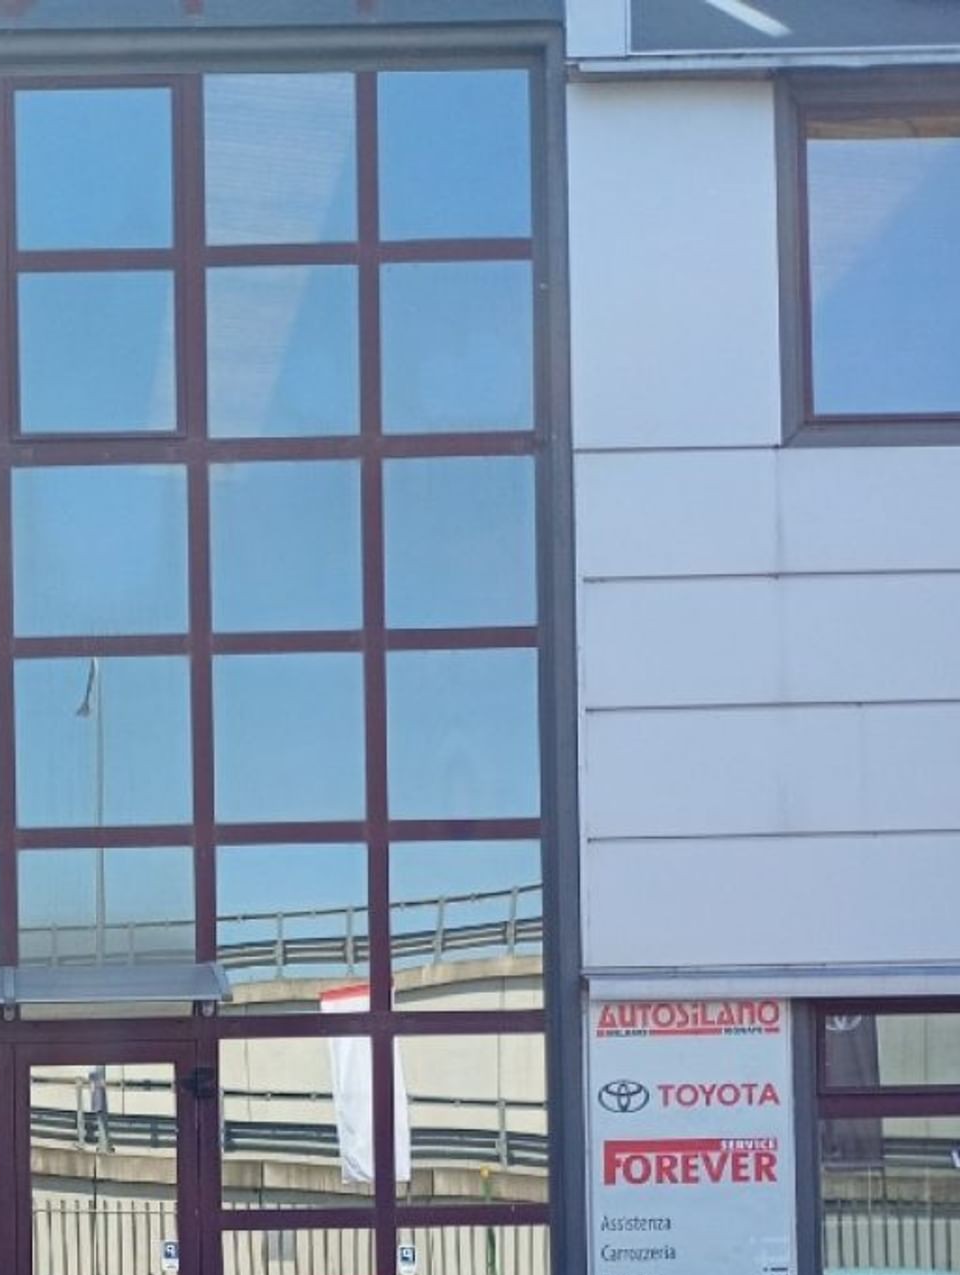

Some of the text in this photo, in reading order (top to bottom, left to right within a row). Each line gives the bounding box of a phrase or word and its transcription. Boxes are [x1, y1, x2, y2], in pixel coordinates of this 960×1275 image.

[657, 1083, 780, 1107] TOYOTA
[603, 1146, 778, 1186] FOREVER
[600, 1215, 672, 1232] Assistenza
[600, 1245, 677, 1262] Carrozzeria
